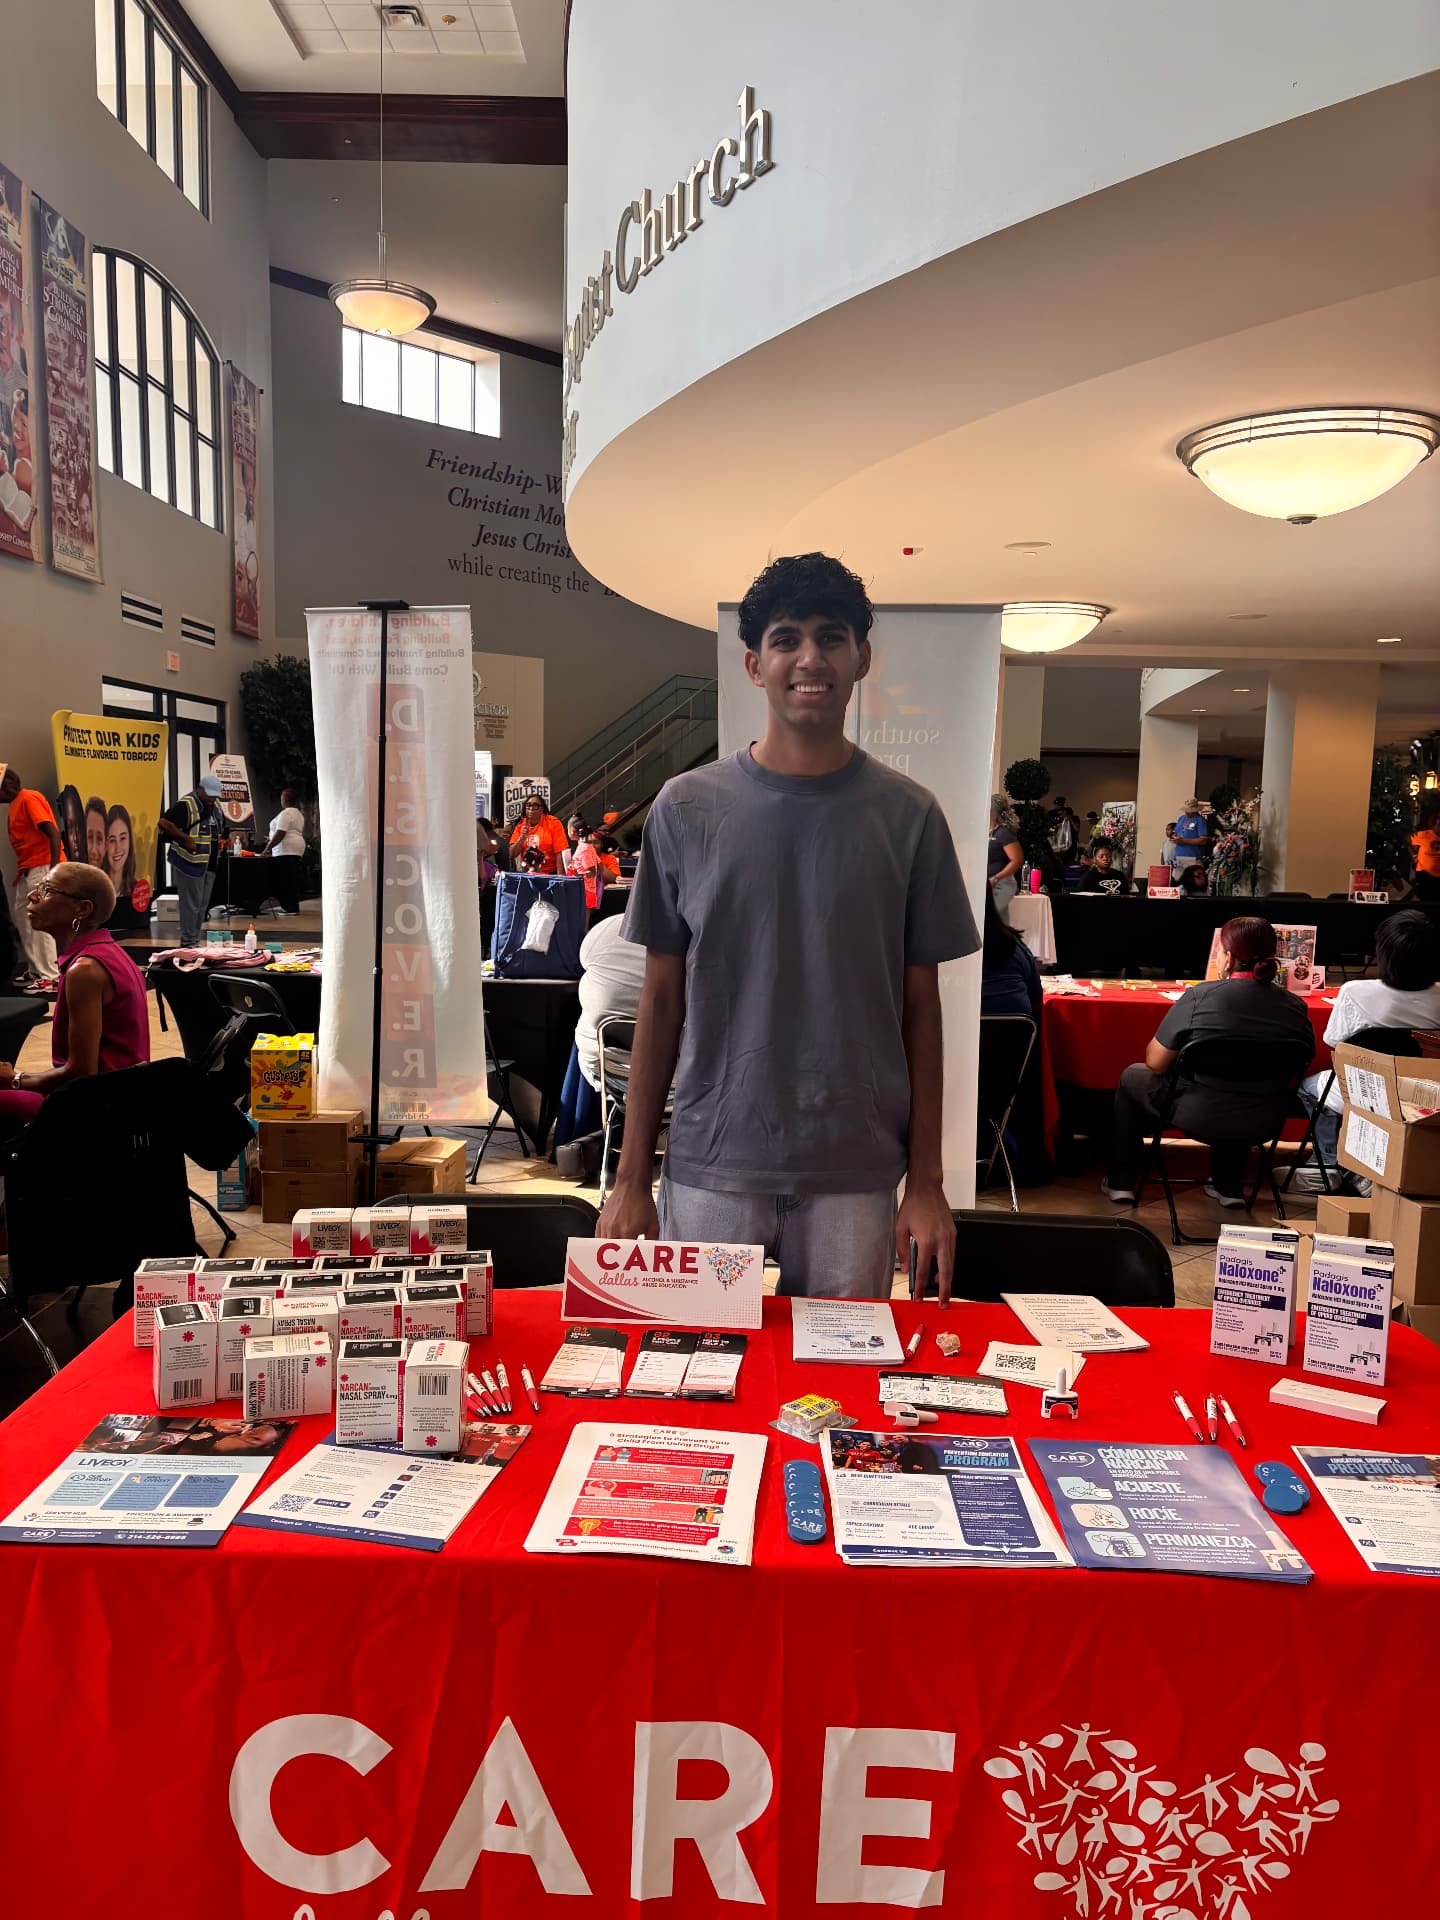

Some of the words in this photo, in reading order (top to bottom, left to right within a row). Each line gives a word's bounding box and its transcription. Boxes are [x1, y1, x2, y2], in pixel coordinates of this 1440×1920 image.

[616, 85, 776, 294] Church
[43, 286, 82, 327] STRONGER
[47, 305, 88, 344] COMMUNIT
[448, 486, 530, 520] Christian
[535, 503, 565, 528] Mo
[471, 524, 518, 549] Jesus
[522, 532, 573, 559] Christ
[447, 553, 494, 577] while
[499, 565, 562, 594] creating
[566, 570, 590, 593] the
[63, 724, 92, 745] PROTECT
[95, 730, 121, 748] OUR
[126, 732, 161, 749] KIDS
[86, 746, 118, 761] FLAVORED
[121, 750, 158, 762] TOBACCO
[505, 785, 549, 803] COLLEGE
[317, 1223, 342, 1232] LIVEGY
[377, 1222, 401, 1231] LIVEGY
[435, 1220, 459, 1229] LIVEGY
[596, 1242, 700, 1274] CARE
[1219, 1261, 1279, 1283] Naloxone
[1313, 1269, 1349, 1282] Padagis
[598, 1272, 640, 1287] dallas
[1312, 1276, 1377, 1301] Naloxone
[136, 1292, 162, 1300] NARCAN
[197, 1294, 222, 1302] NARCAN
[136, 1301, 157, 1309] NASAL
[157, 1299, 178, 1308] SPRAY
[277, 1319, 296, 1328] SPRAY
[296, 1318, 316, 1327] NASAL
[404, 1323, 431, 1333] NARCAN
[340, 1326, 368, 1336] NARCAN
[426, 1330, 446, 1340] SPRAY
[301, 1362, 309, 1374] mg
[248, 1381, 257, 1400] NASAL
[257, 1380, 266, 1405] NARCAN
[340, 1382, 370, 1392] NARCAN
[339, 1391, 363, 1401] NASAL
[363, 1390, 387, 1400] SPRAY
[616, 1433, 662, 1442] Strategies
[952, 1440, 984, 1448] CARE
[693, 1442, 720, 1450] Drugs
[943, 1449, 978, 1457] PREVENTION
[1047, 1454, 1088, 1462] CARE
[1097, 1446, 1149, 1461] CÓMO
[1148, 1449, 1189, 1461] USAR
[77, 1457, 133, 1467] LIVEGY
[944, 1454, 1009, 1467] PROGRAM
[1101, 1458, 1170, 1471] NARCAN
[1326, 1463, 1417, 1474] PREVENTION
[1114, 1480, 1187, 1494] ACUESTE
[1127, 1505, 1183, 1522] ROCÍE
[792, 1517, 823, 1533] CARE
[1143, 1533, 1258, 1549] PERMANEZCA
[228, 1713, 957, 1908] CARE
